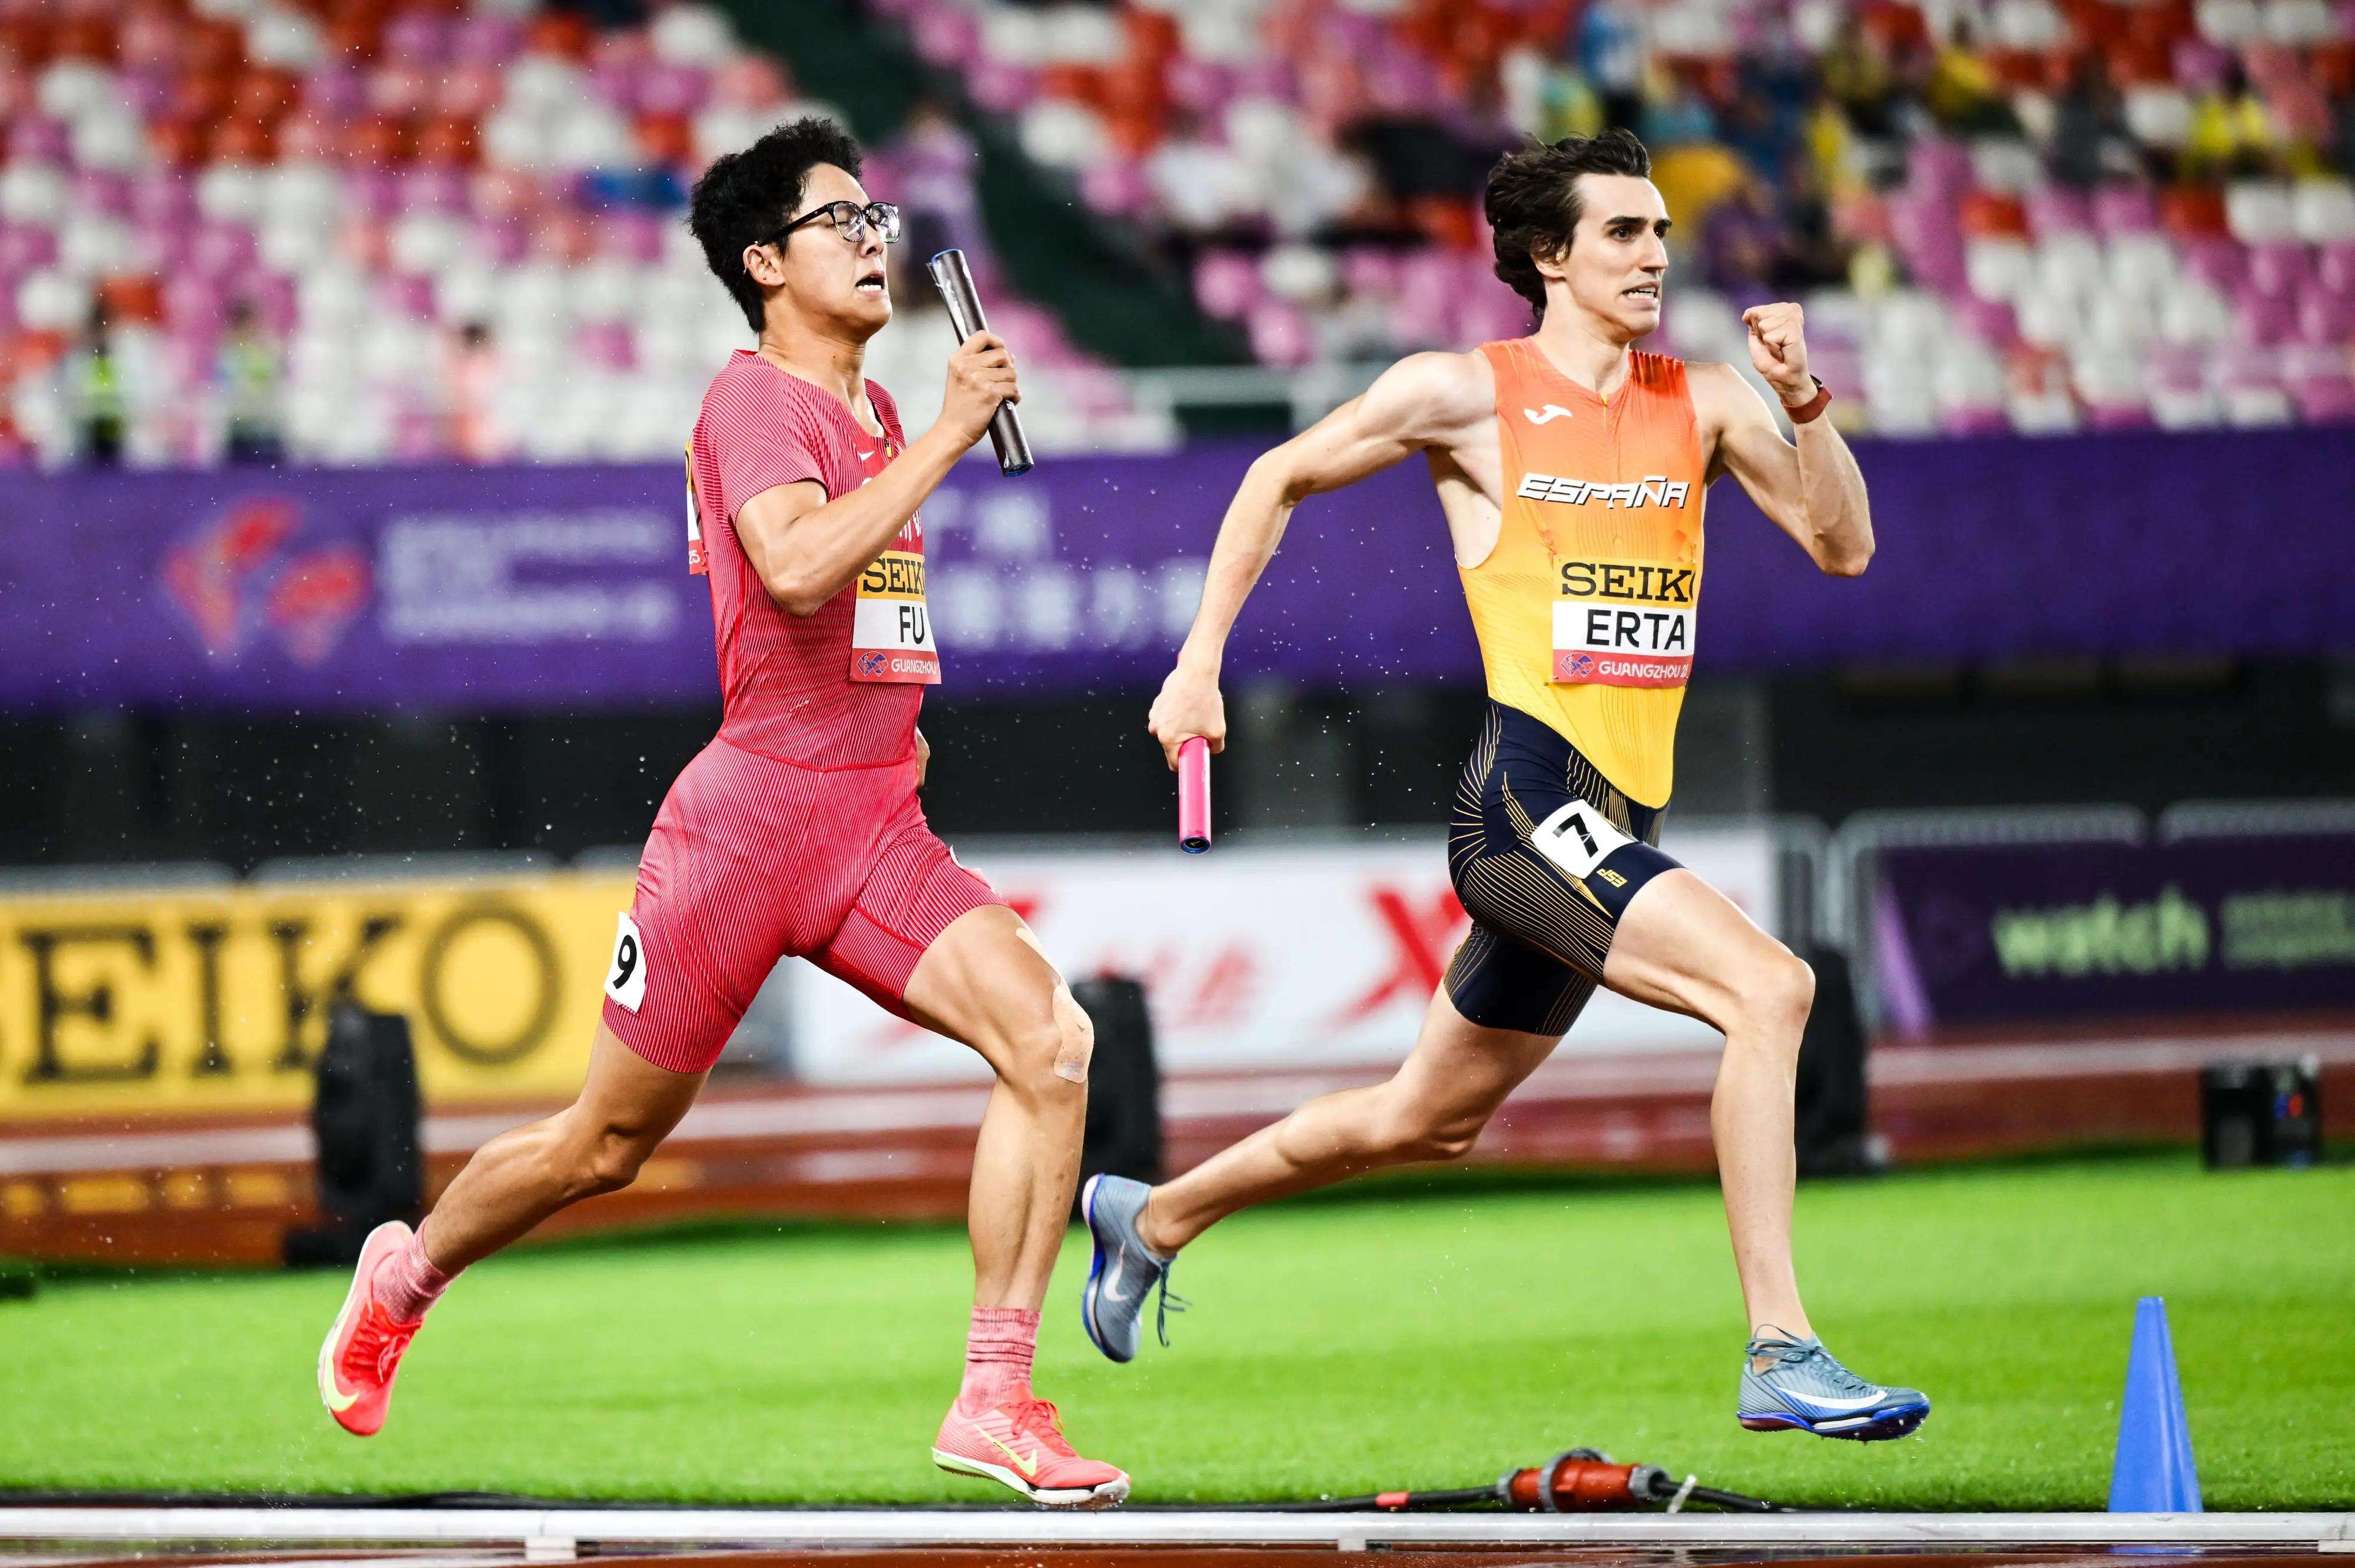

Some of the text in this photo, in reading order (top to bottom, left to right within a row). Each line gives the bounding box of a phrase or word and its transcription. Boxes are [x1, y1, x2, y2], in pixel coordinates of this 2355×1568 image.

[1517, 472, 1690, 509] ESPAÑA
[863, 558, 926, 595] SEIK
[1561, 562, 1696, 603] SEIK
[899, 606, 925, 645] FU
[1586, 609, 1684, 650] ERTA
[891, 658, 937, 675] GUANGZHOU
[1598, 660, 1680, 679] GUANGZHOU
[1552, 812, 1599, 859] 7
[612, 934, 637, 989] 9
[0, 899, 564, 1083] EIKO
